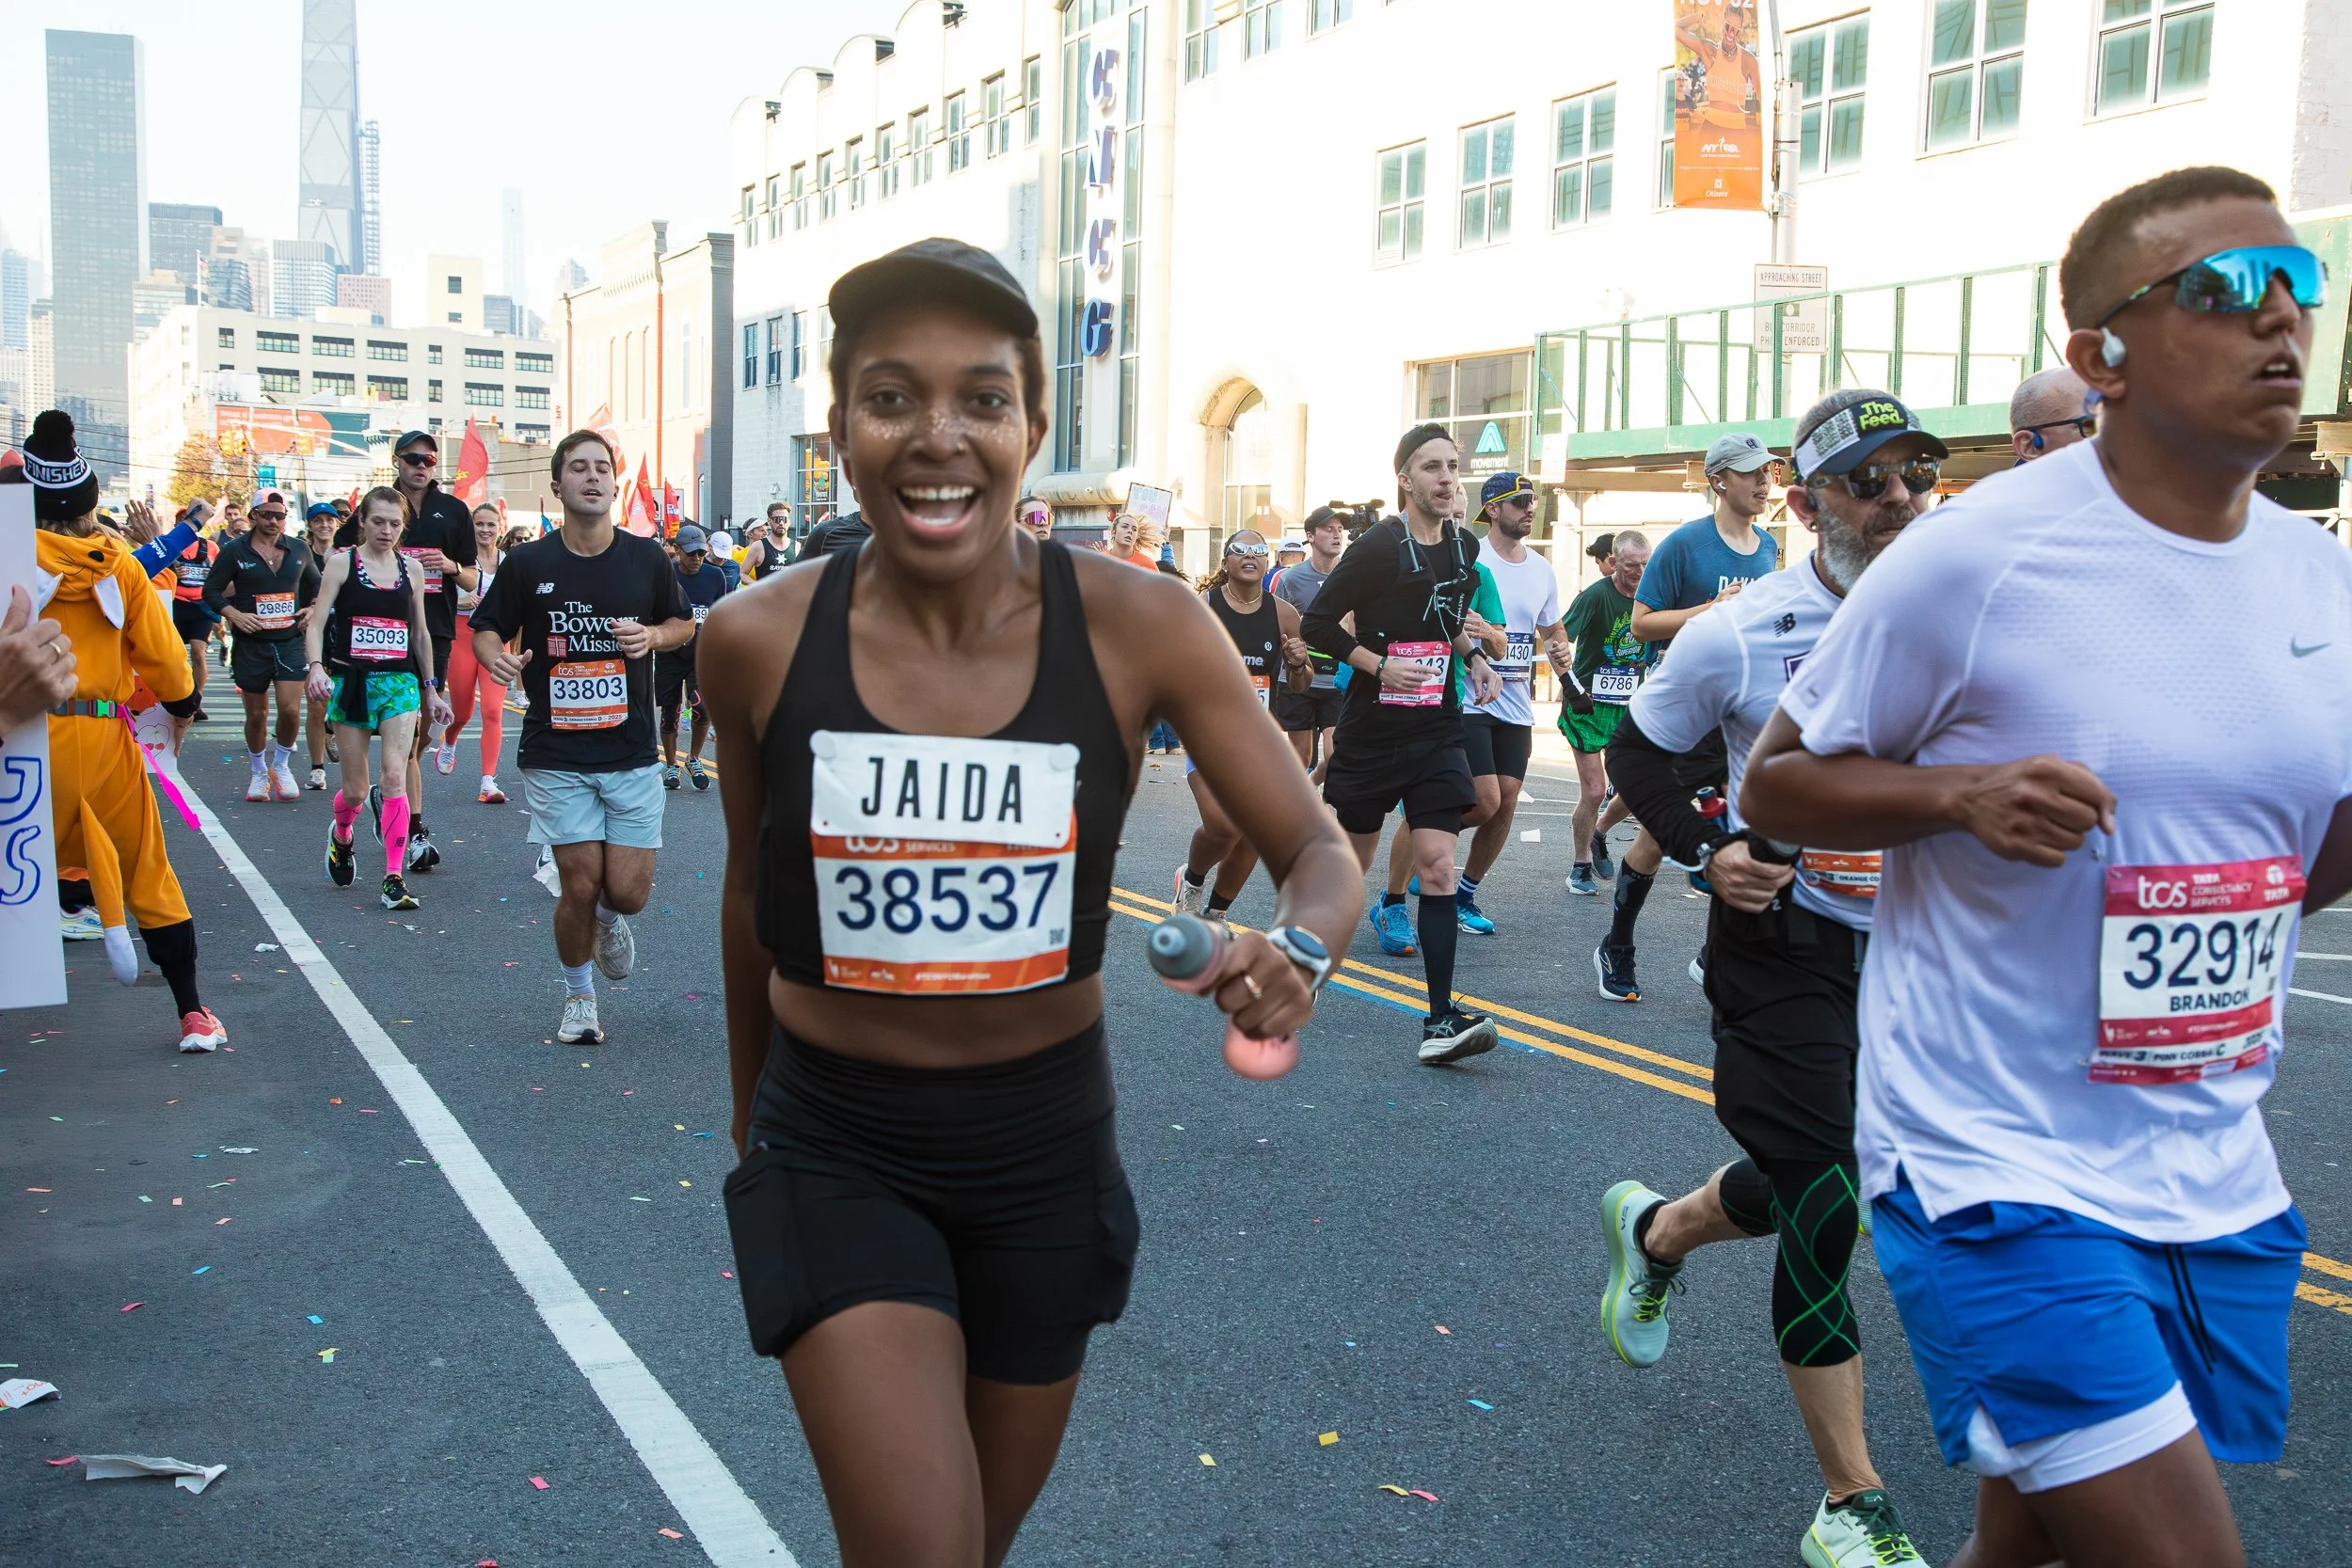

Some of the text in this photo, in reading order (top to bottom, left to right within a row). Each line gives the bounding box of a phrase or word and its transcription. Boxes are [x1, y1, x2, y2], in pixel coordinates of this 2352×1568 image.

[1760, 272, 1821, 283] APPROACHING STREET
[1784, 336, 1820, 346] ENFORCED
[1861, 401, 1895, 416] The
[1470, 455, 1509, 469] movement
[26, 457, 87, 483] FINISHER
[259, 602, 293, 614] 29866
[564, 602, 593, 613] The
[355, 627, 405, 644] 35093
[558, 665, 574, 676] tcs
[553, 676, 623, 700] 33803
[1600, 676, 1633, 690] 6786
[861, 756, 1022, 824] JAIDA
[2191, 873, 2221, 884] TATA
[2137, 875, 2188, 910] tcs
[2191, 881, 2253, 895] CONSULTANCY
[2264, 887, 2290, 902] TATA
[834, 862, 1059, 935] 38537
[2190, 895, 2232, 908] SERVICES
[2122, 911, 2283, 990] 32914
[2169, 988, 2250, 1012] BRANDON
